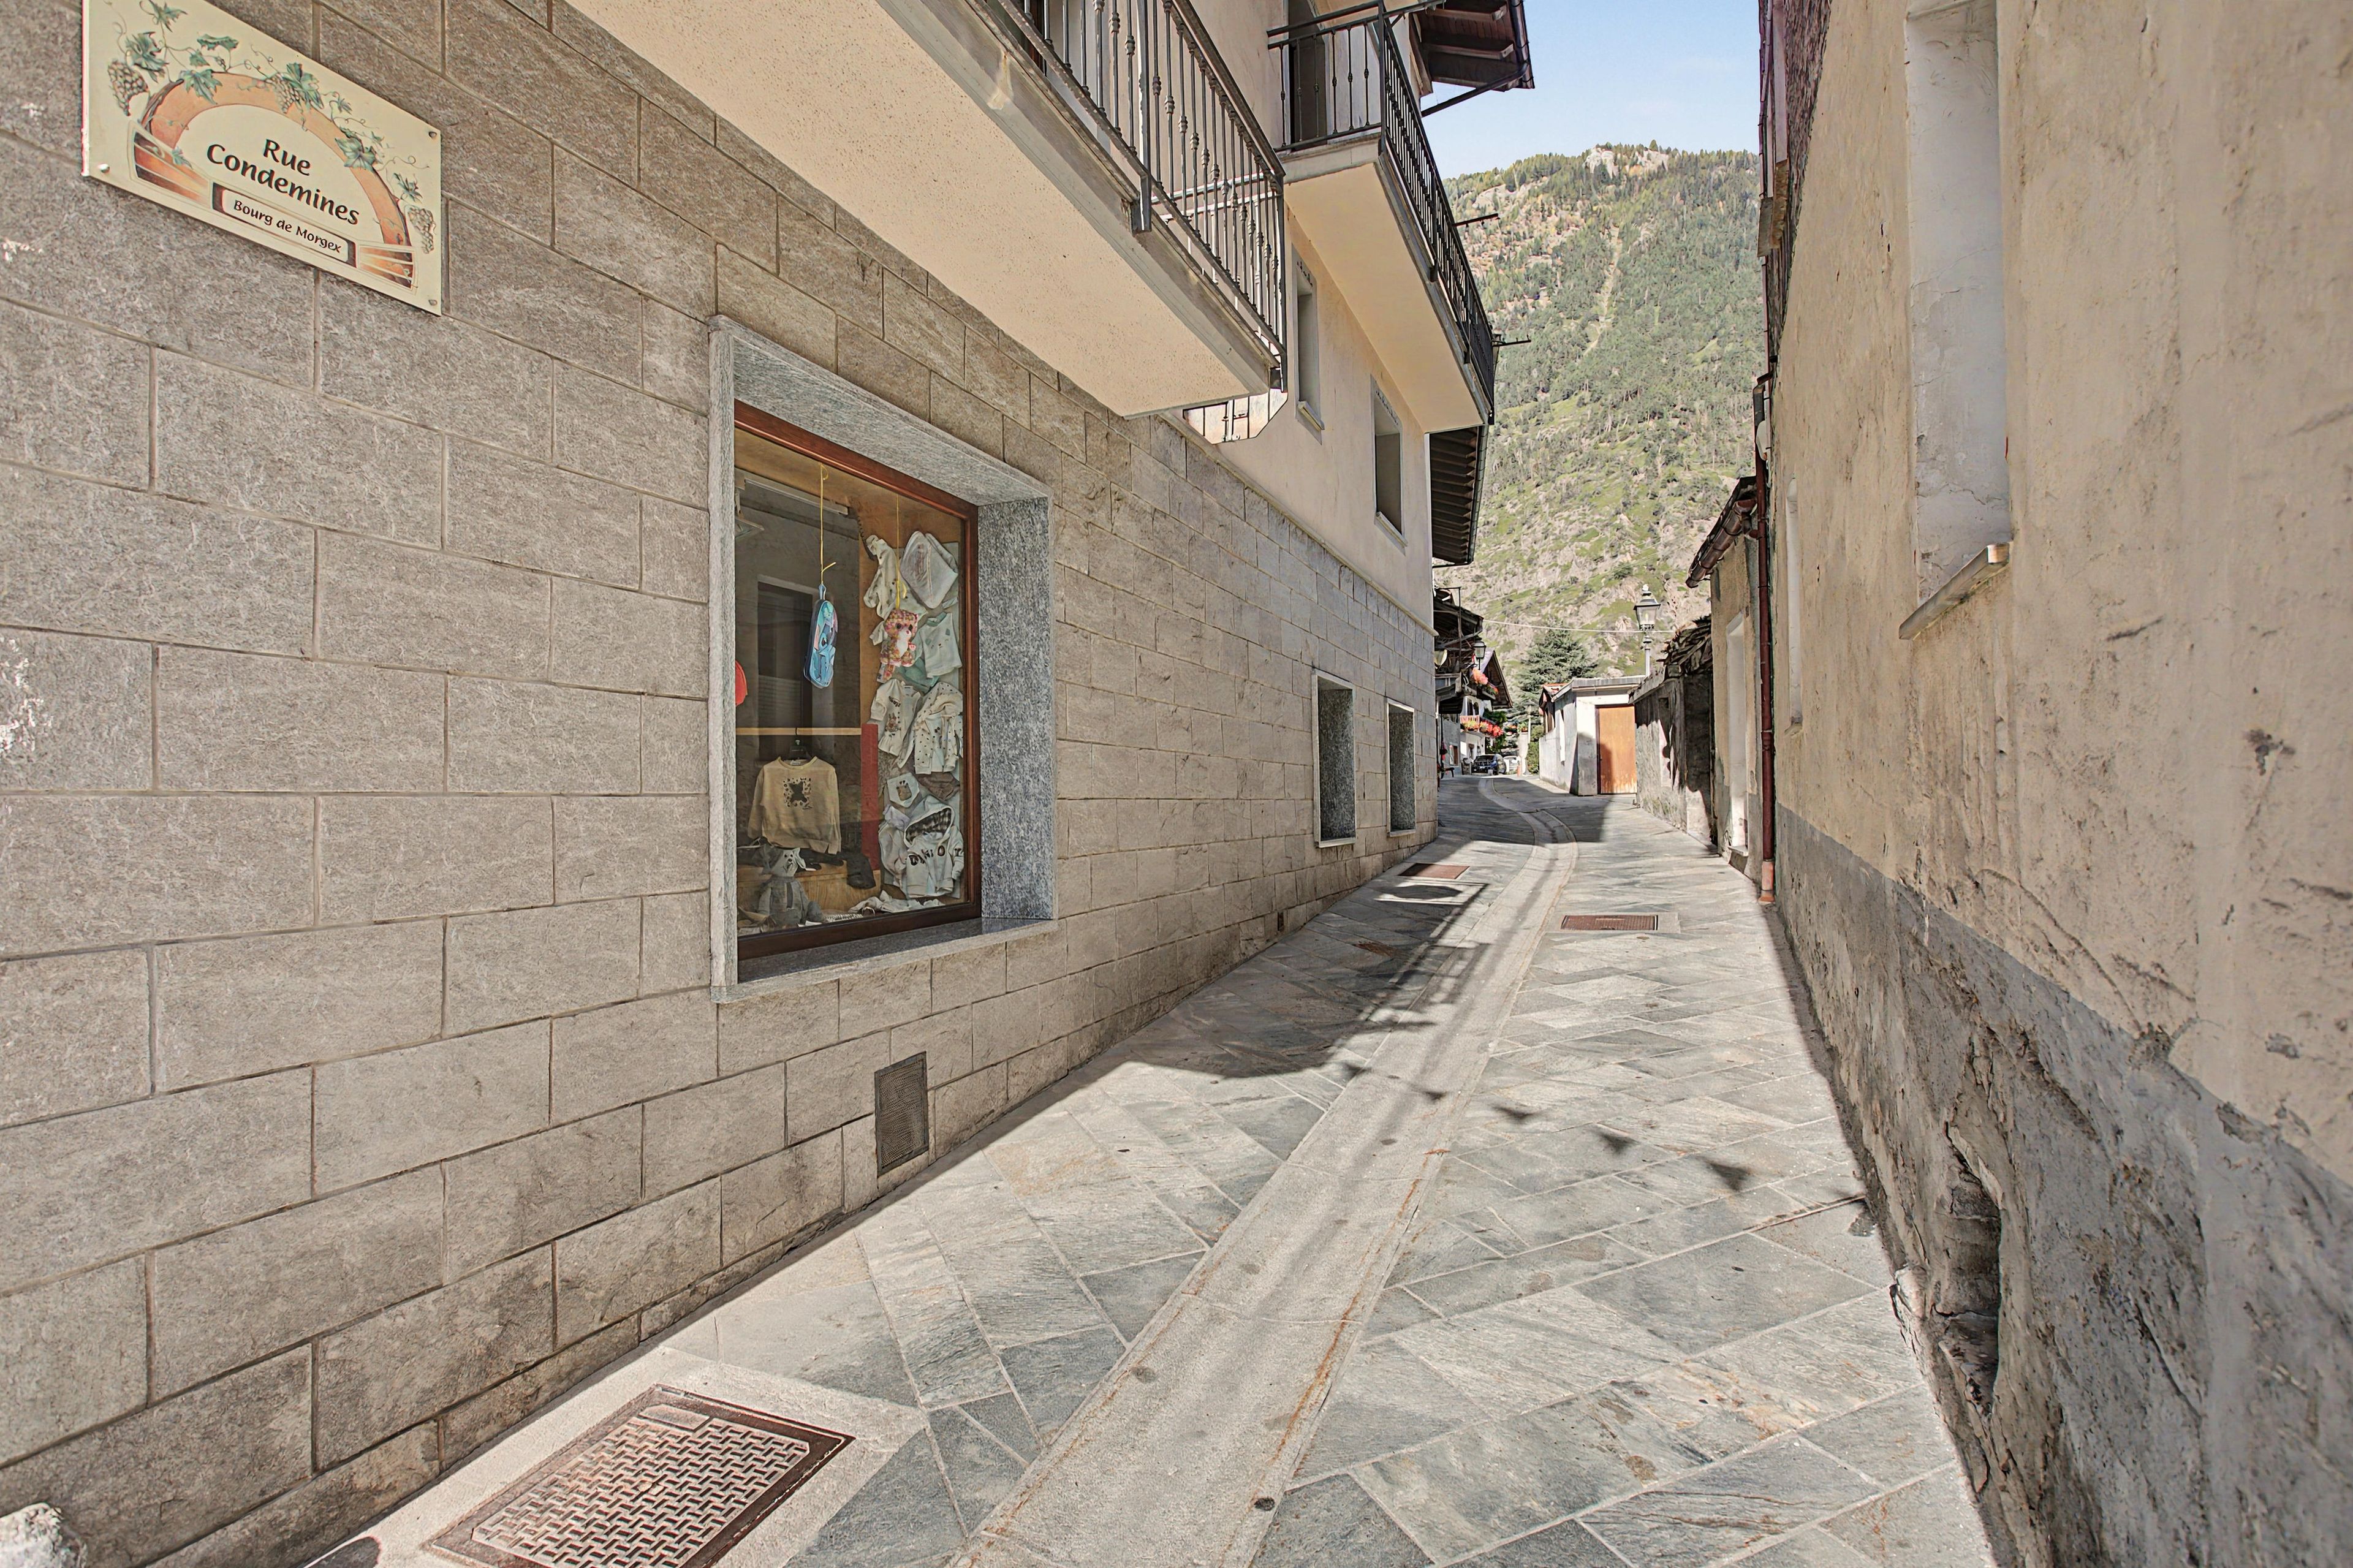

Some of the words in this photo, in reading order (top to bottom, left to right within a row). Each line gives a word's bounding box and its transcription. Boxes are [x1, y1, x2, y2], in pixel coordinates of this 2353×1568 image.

[207, 144, 360, 225] Condemines
[263, 138, 311, 176] Rue
[233, 199, 273, 226] Bourg
[276, 219, 293, 233] de
[295, 225, 342, 254] Morgex
